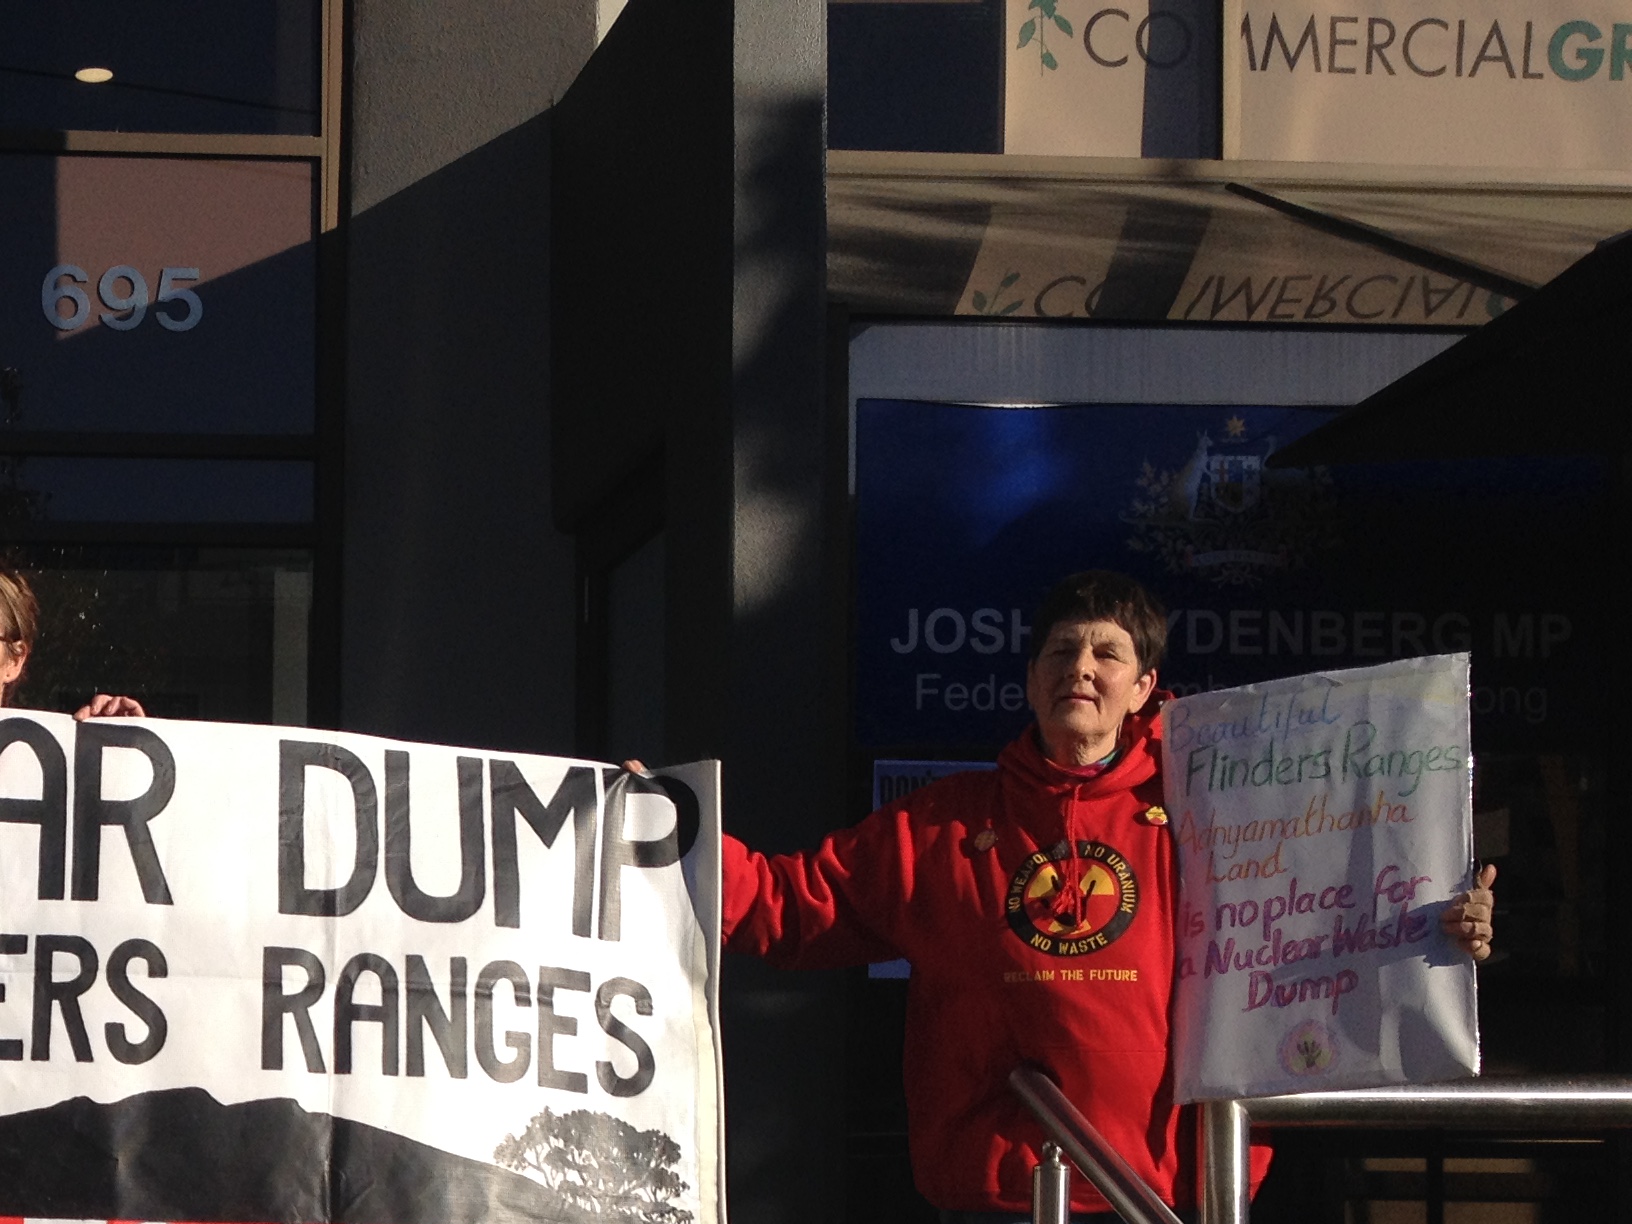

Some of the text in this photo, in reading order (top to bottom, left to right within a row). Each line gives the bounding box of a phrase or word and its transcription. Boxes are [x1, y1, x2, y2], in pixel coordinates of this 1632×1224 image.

[41, 264, 204, 332] 695
[1493, 611, 1573, 659] MP
[915, 673, 1034, 712] Fede
[1169, 681, 1343, 753] Beautiful
[1186, 720, 1461, 797] Flinders Ranges
[278, 739, 702, 943] DUMP
[1206, 842, 1291, 883] Land
[1084, 844, 1136, 914] NO URANIUM
[1182, 901, 1205, 937] is
[1372, 865, 1433, 923] for
[1030, 932, 1109, 955] NO WASTE
[1178, 902, 1431, 980] a Nuclear Waste
[1004, 970, 1138, 983] RECLAIM THE FUTURE
[1243, 968, 1360, 1016] Dump
[260, 946, 656, 1098] RANGES
